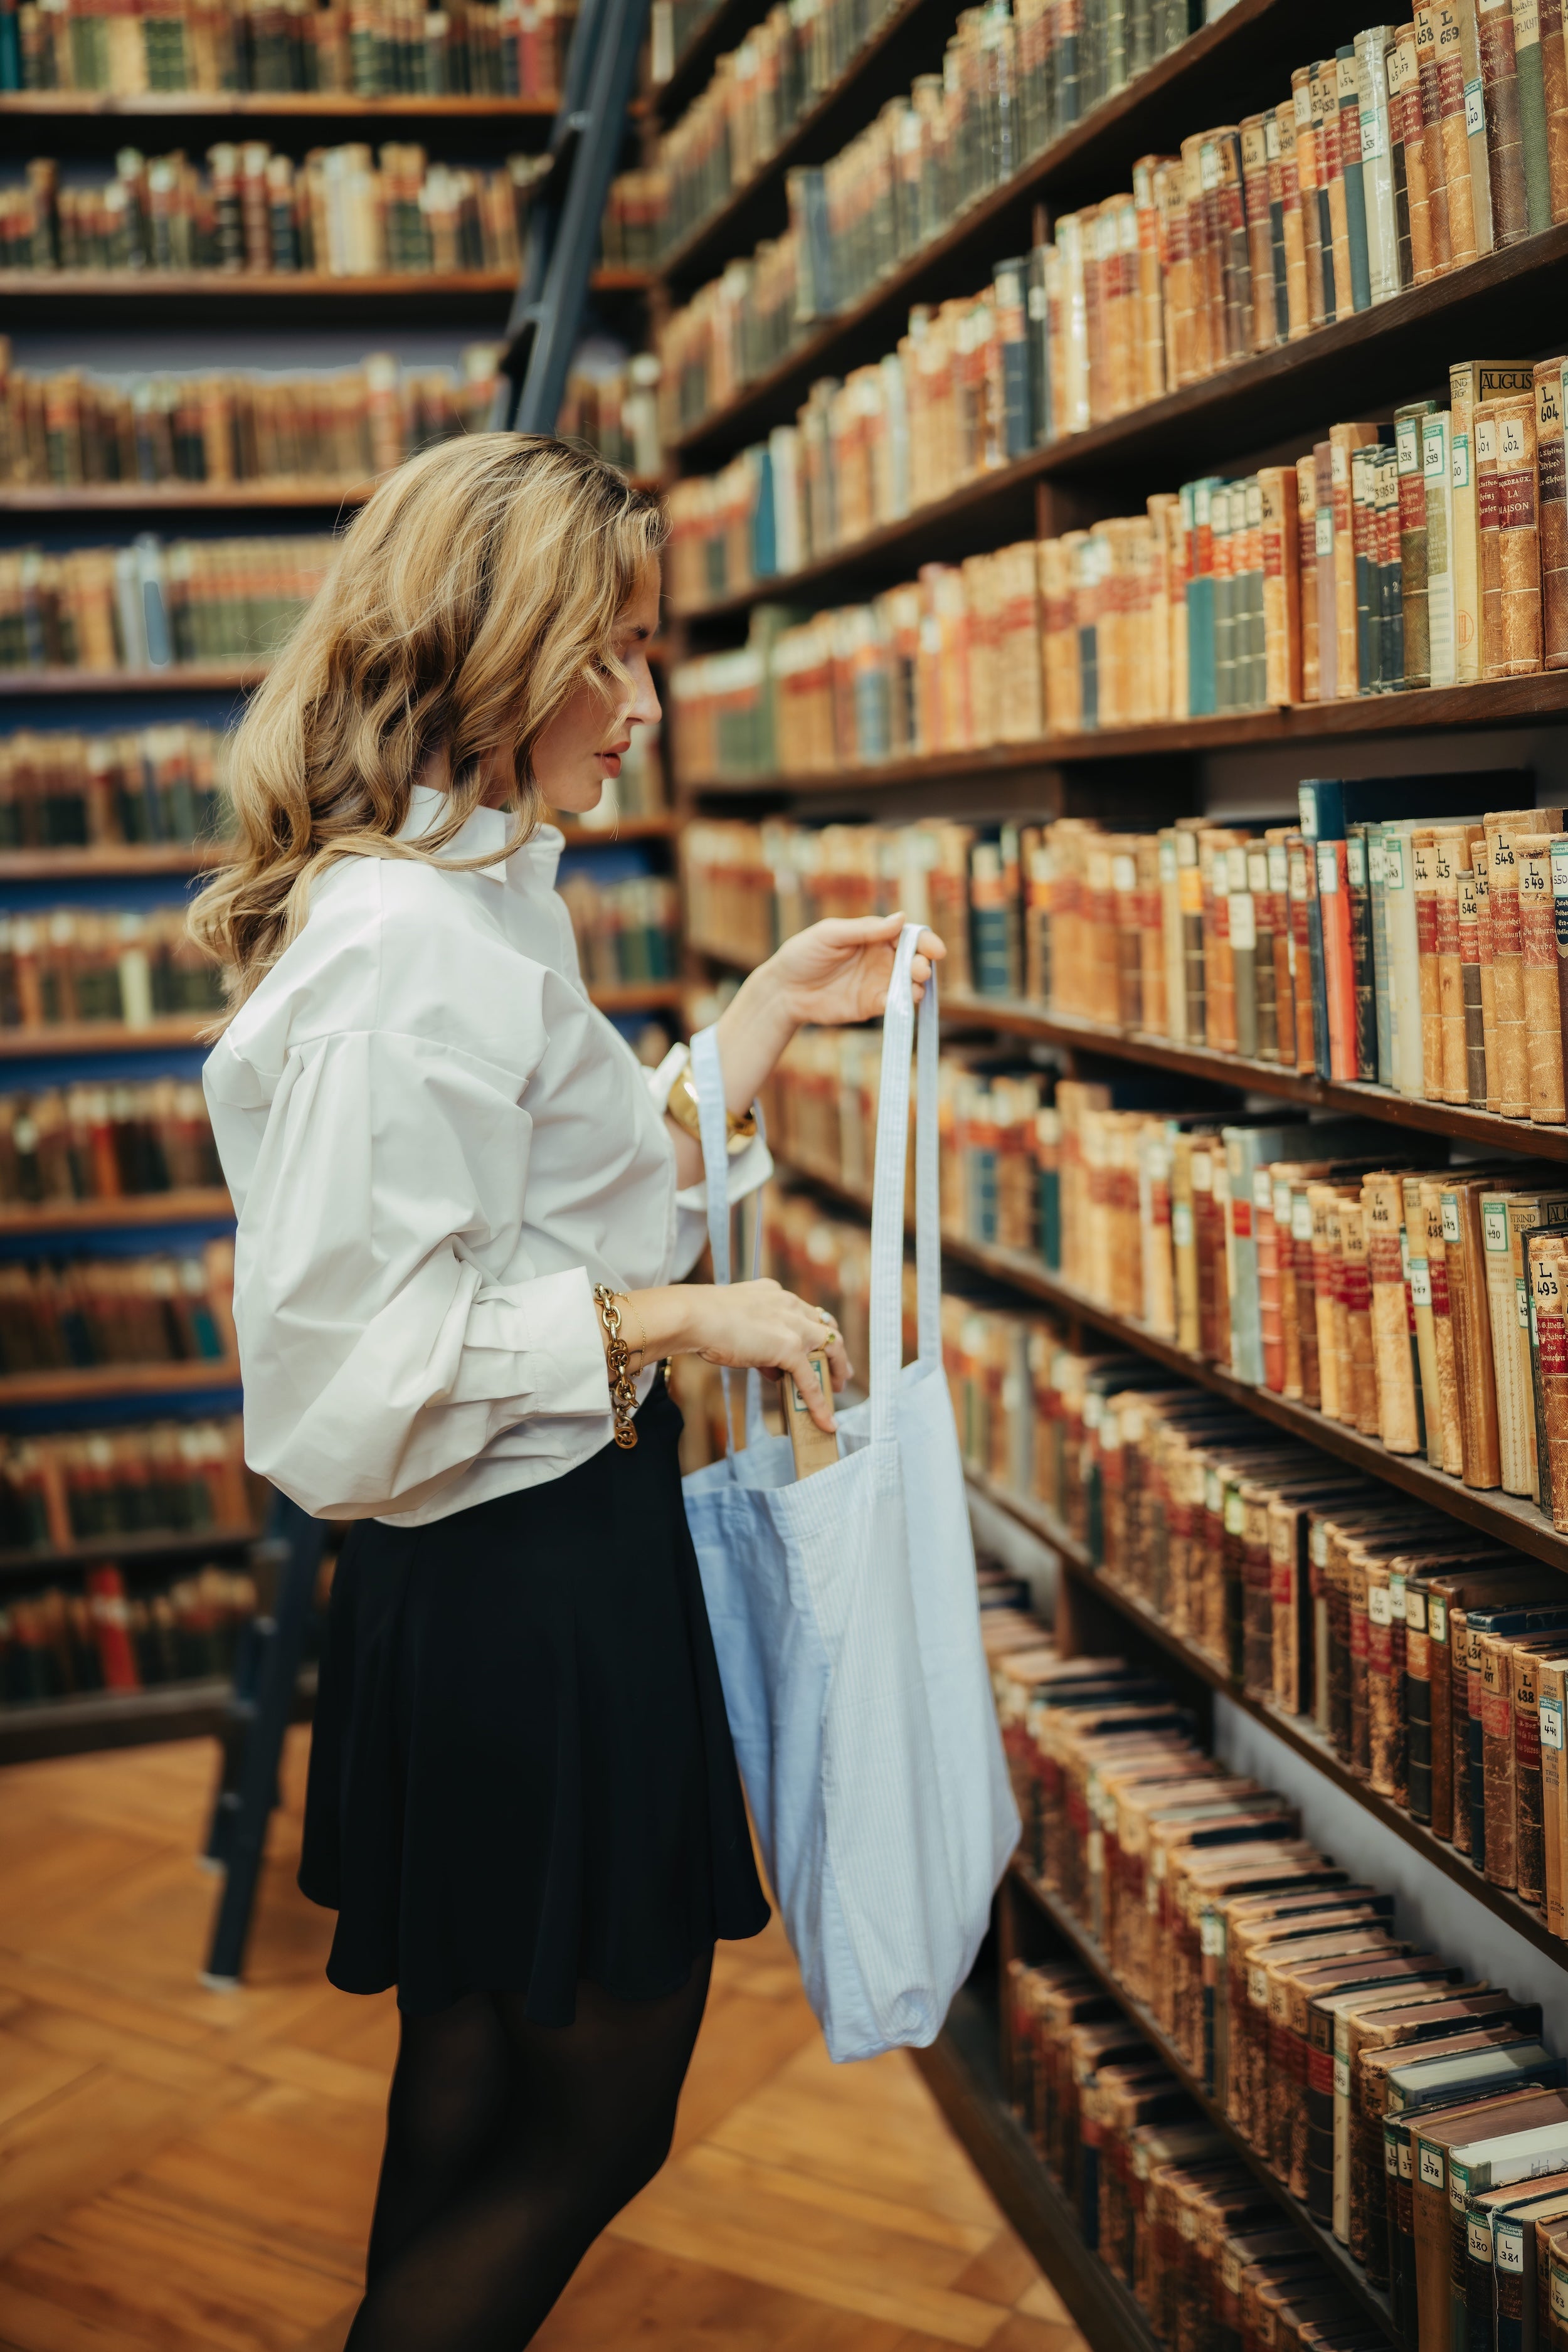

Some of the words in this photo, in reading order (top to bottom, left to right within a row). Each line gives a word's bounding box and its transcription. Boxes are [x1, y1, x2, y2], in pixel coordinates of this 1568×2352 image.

[1418, 12, 1429, 27] L
[1441, 10, 1454, 26] L
[1416, 26, 1434, 45] 658
[1439, 26, 1460, 45] 659
[1400, 51, 1406, 61] L
[1342, 64, 1349, 75] L
[1393, 58, 1399, 69] L
[1469, 100, 1474, 112] L
[1364, 130, 1370, 138] L
[1481, 373, 1534, 390] AUGUS
[1541, 386, 1554, 403] L
[1540, 403, 1560, 423] 604
[1479, 427, 1485, 439] L
[1507, 426, 1513, 438] L
[1402, 439, 1408, 448] L
[1428, 442, 1434, 452] L
[1503, 440, 1519, 453] 602
[1426, 453, 1438, 465] 599
[1507, 489, 1518, 499] LA
[1498, 501, 1529, 514] MAISON
[1498, 835, 1510, 850] L
[1416, 851, 1425, 864] L
[1437, 849, 1446, 864] L
[1495, 851, 1515, 866] 548
[1389, 859, 1394, 867] L
[1529, 862, 1539, 876] L
[1555, 860, 1562, 871] L
[1477, 864, 1487, 876] L
[1525, 877, 1544, 889] 549
[1554, 875, 1567, 885] 550
[1465, 888, 1473, 900] L
[1462, 903, 1477, 914] 546
[1428, 1210, 1438, 1221] L
[1444, 1209, 1450, 1219] L
[1490, 1217, 1496, 1227] L
[1486, 1229, 1501, 1239] 490
[1539, 1262, 1552, 1278] L
[1537, 1281, 1558, 1296] 493
[1521, 1295, 1527, 1303] L
[1519, 1306, 1527, 1316] 49
[1486, 1658, 1491, 1671] L
[1522, 1674, 1532, 1688] L
[1548, 1714, 1554, 1724] L
[1406, 2149, 1412, 2161] L
[1428, 2154, 1434, 2166] L
[1402, 2161, 1412, 2172] 37
[1422, 2163, 1439, 2178] 378
[1451, 2178, 1458, 2190] L
[1475, 2229, 1481, 2240] L
[1469, 2237, 1488, 2252] 380
[1505, 2240, 1513, 2250] L
[1499, 2250, 1519, 2264] 381
[1555, 2280, 1562, 2296] L
